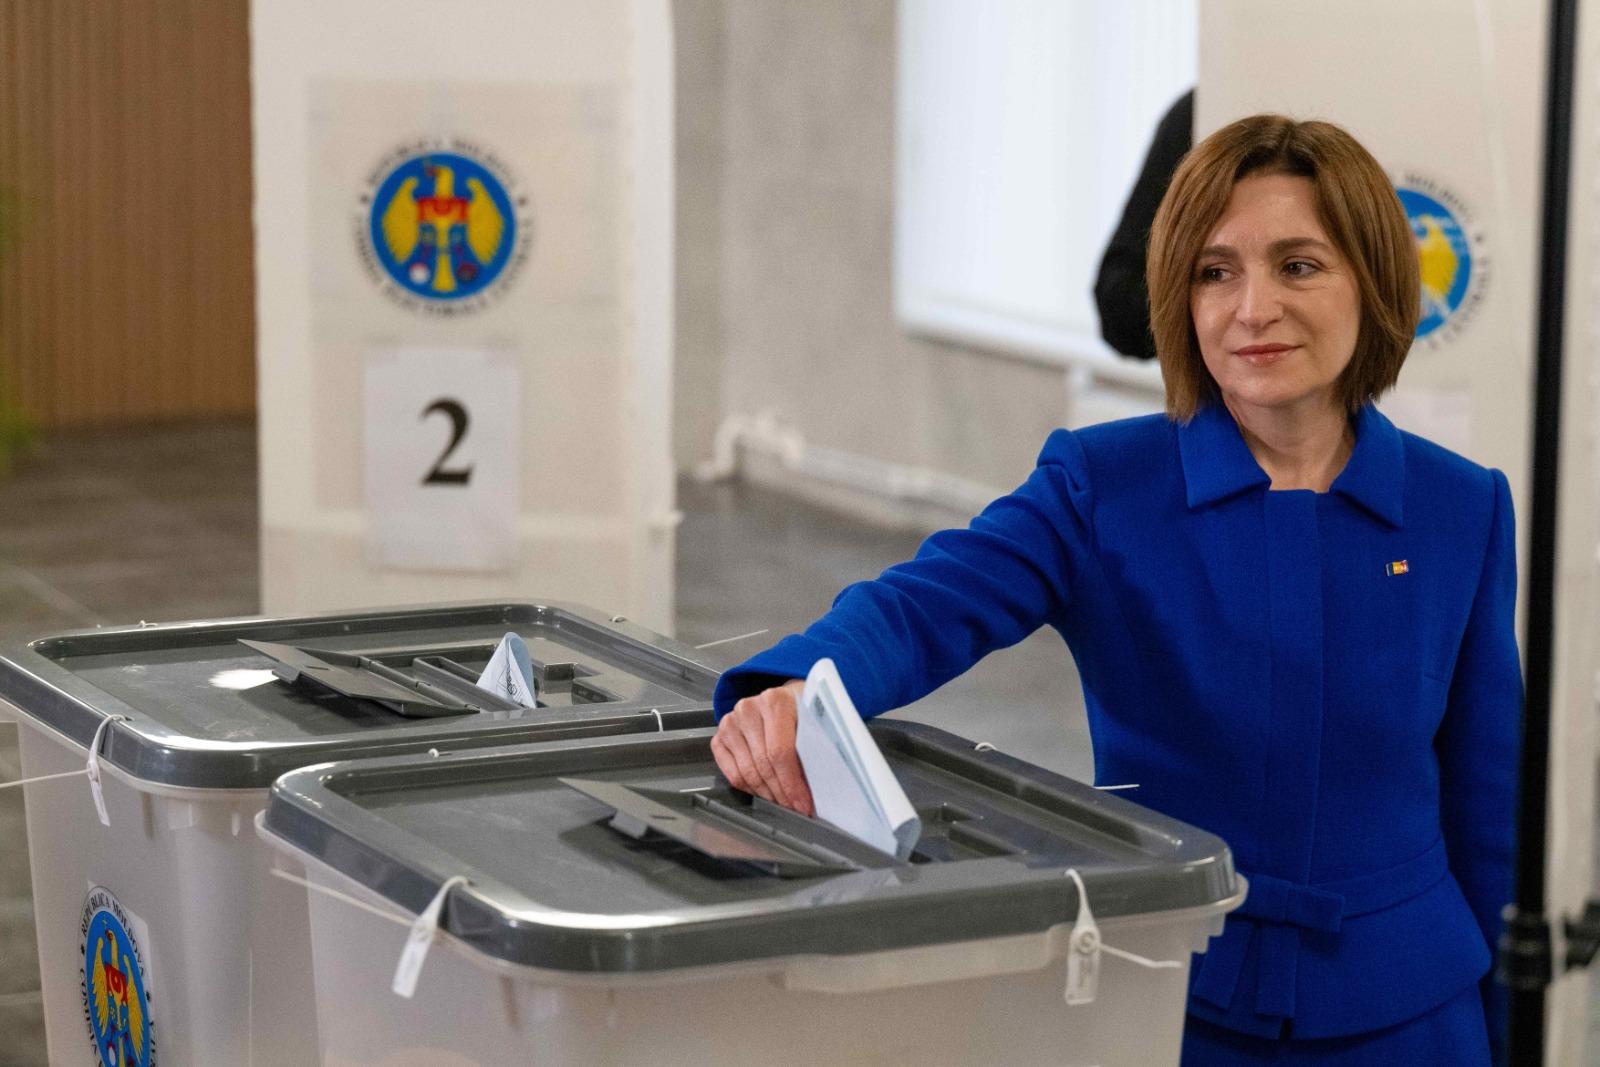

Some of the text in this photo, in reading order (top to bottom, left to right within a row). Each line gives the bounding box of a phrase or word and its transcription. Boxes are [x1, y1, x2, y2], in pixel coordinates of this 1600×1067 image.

[420, 397, 475, 487] 2
[81, 891, 145, 977] REPUBLICA MOLDOVA
